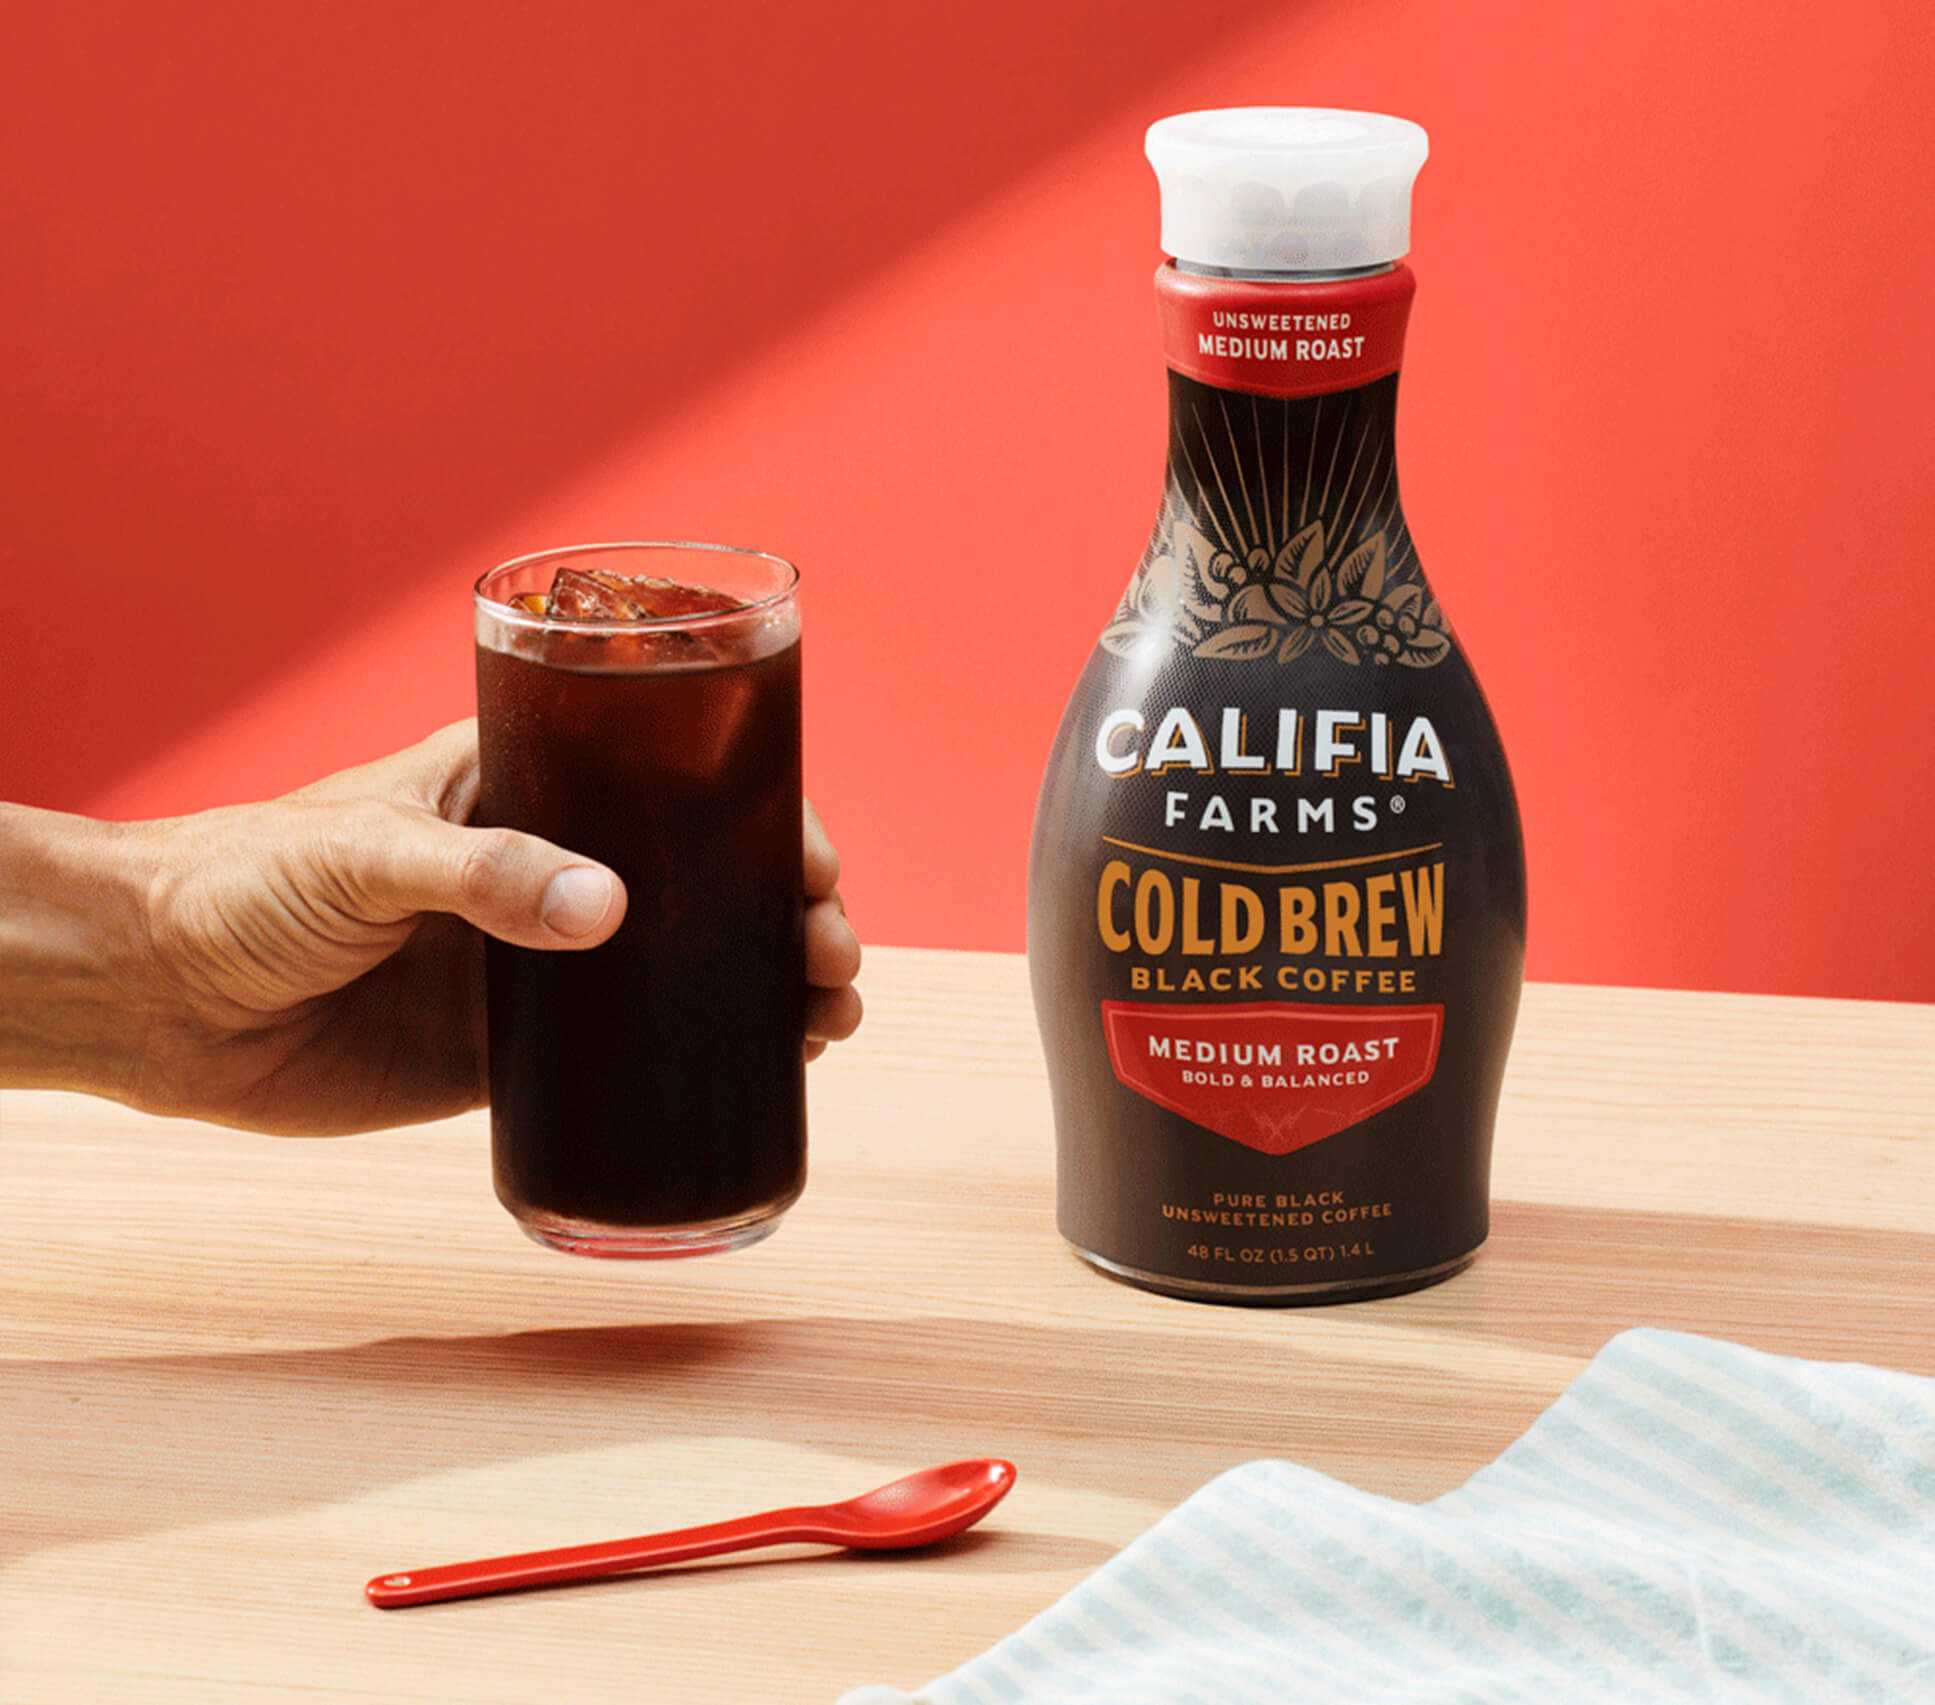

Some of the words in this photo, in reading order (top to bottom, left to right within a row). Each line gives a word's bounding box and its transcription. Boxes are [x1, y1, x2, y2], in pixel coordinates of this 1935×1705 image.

[1212, 311, 1351, 331] UNSWEETENED
[1199, 333, 1288, 361] MEDIUM
[1296, 336, 1365, 361] ROAST
[1096, 707, 1455, 789] CALIFIA
[1098, 860, 1265, 956] COLD
[1279, 862, 1444, 957] BREW
[1131, 966, 1263, 992] BLACK
[1277, 967, 1416, 993] COFFEE
[1148, 1035, 1282, 1066] MEDIUM
[1297, 1037, 1400, 1066] ROAST
[1182, 1069, 1234, 1088] BOLD
[1240, 1074, 1253, 1087] &
[1261, 1070, 1370, 1089] BALANCED
[1213, 1192, 1266, 1208] PURE
[1276, 1191, 1344, 1208] BLACK
[1162, 1204, 1313, 1227] UNSWEETENED
[1322, 1203, 1392, 1223] COFFEE
[1187, 1244, 1209, 1260] 48
[1214, 1246, 1233, 1262] FL
[1240, 1247, 1264, 1263] OZ
[1269, 1246, 1298, 1265] (1.5
[1304, 1246, 1335, 1262] QT)
[1341, 1243, 1361, 1259] 1.4
[1366, 1243, 1375, 1257] L
